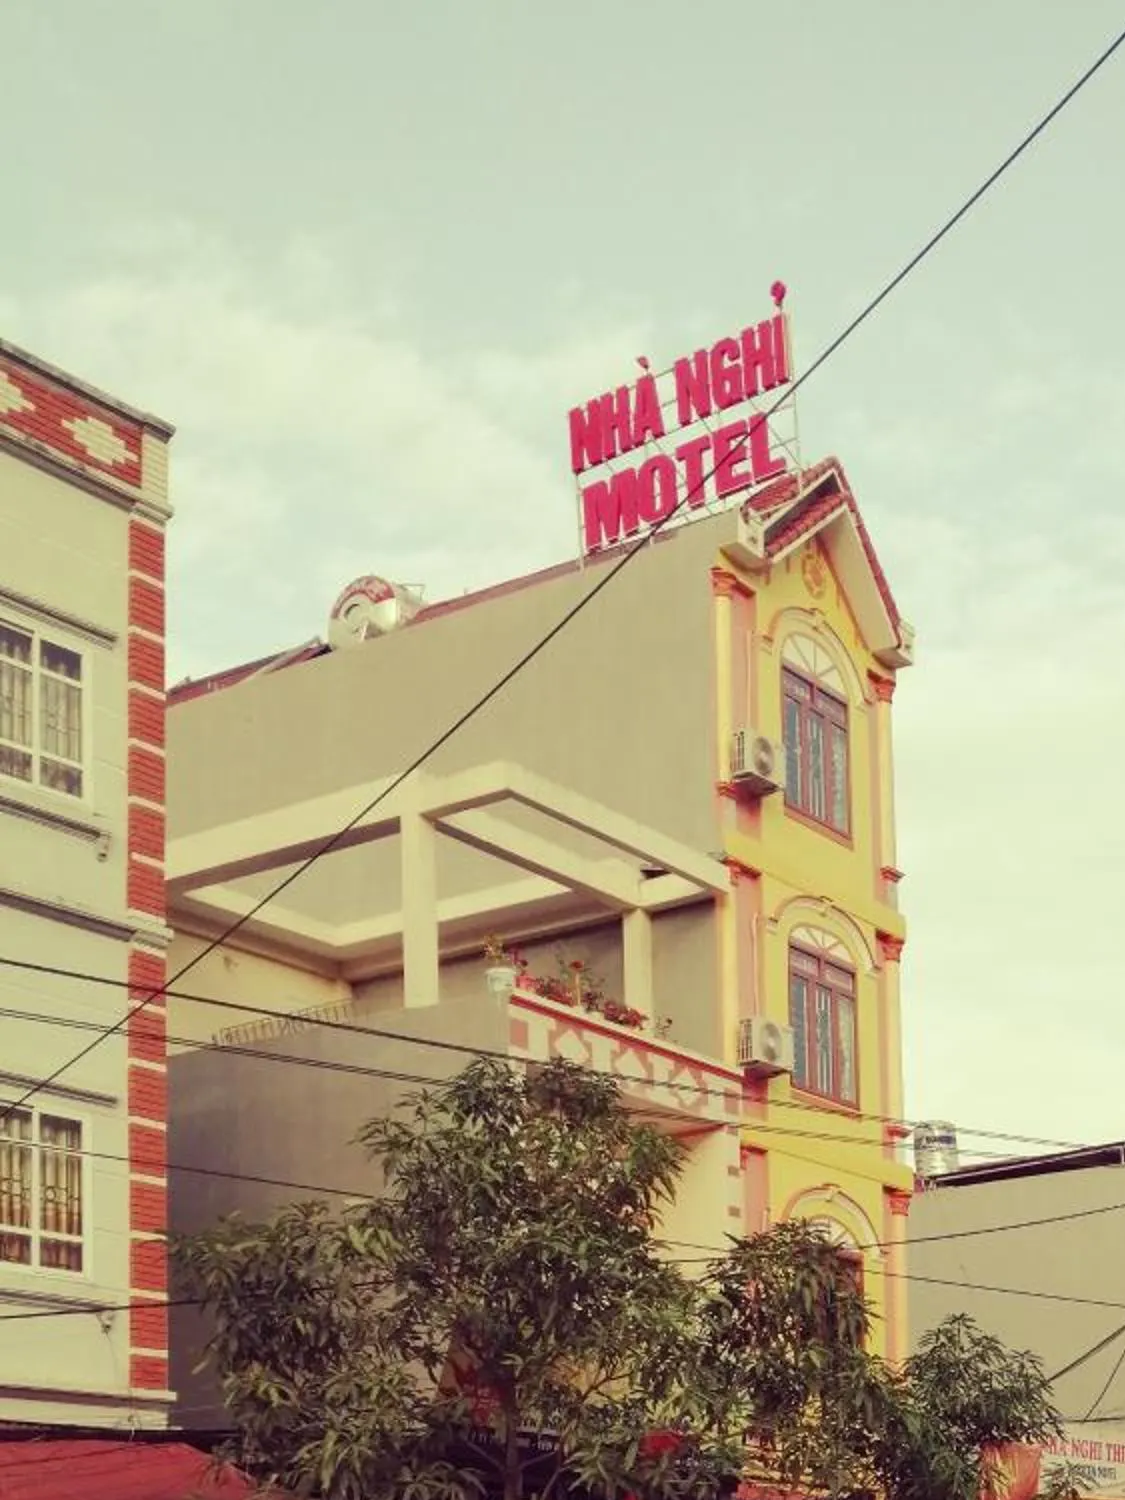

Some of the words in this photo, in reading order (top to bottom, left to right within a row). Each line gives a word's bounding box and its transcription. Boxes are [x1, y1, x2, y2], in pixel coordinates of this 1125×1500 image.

[568, 356, 665, 474] NHÀ
[674, 280, 791, 427] NGHỈ
[582, 411, 788, 556] MOTEL
